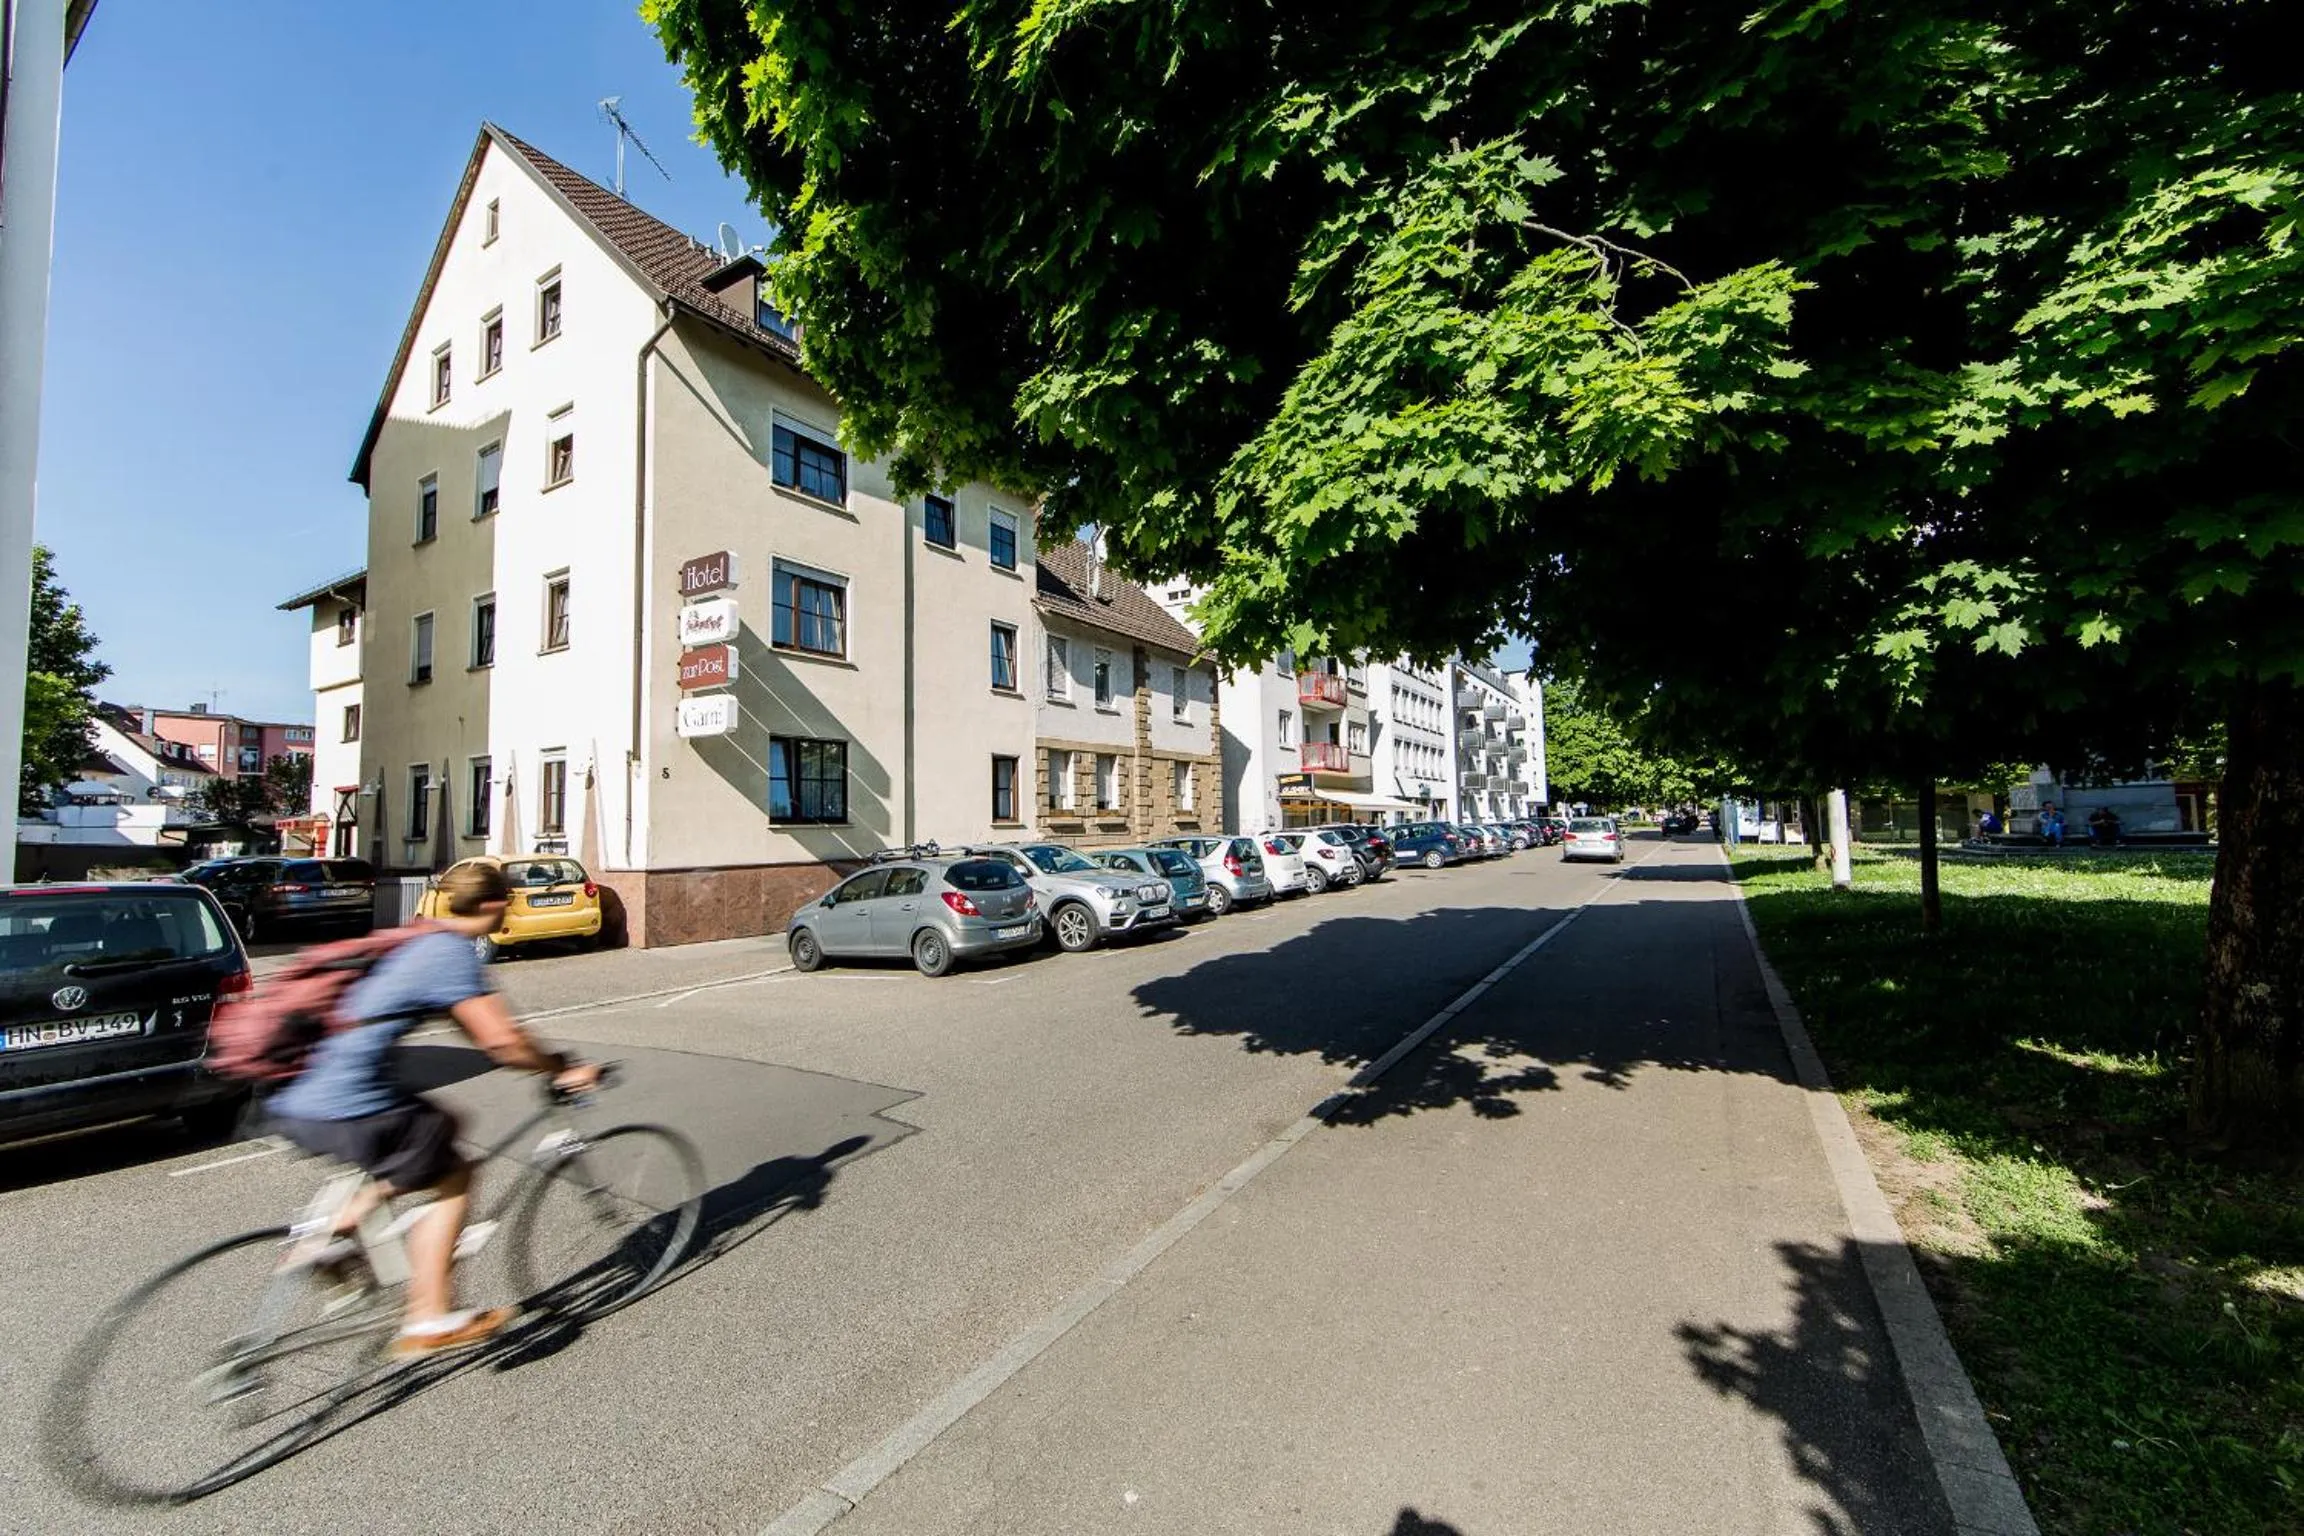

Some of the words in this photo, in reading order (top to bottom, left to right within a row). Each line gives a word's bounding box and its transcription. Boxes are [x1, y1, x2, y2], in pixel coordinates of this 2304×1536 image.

[686, 556, 724, 590] Hotel
[699, 654, 725, 676] Post
[662, 767, 670, 779] 5
[7, 1025, 41, 1045] HN
[59, 1019, 88, 1037] BV
[95, 1012, 137, 1033] 149
